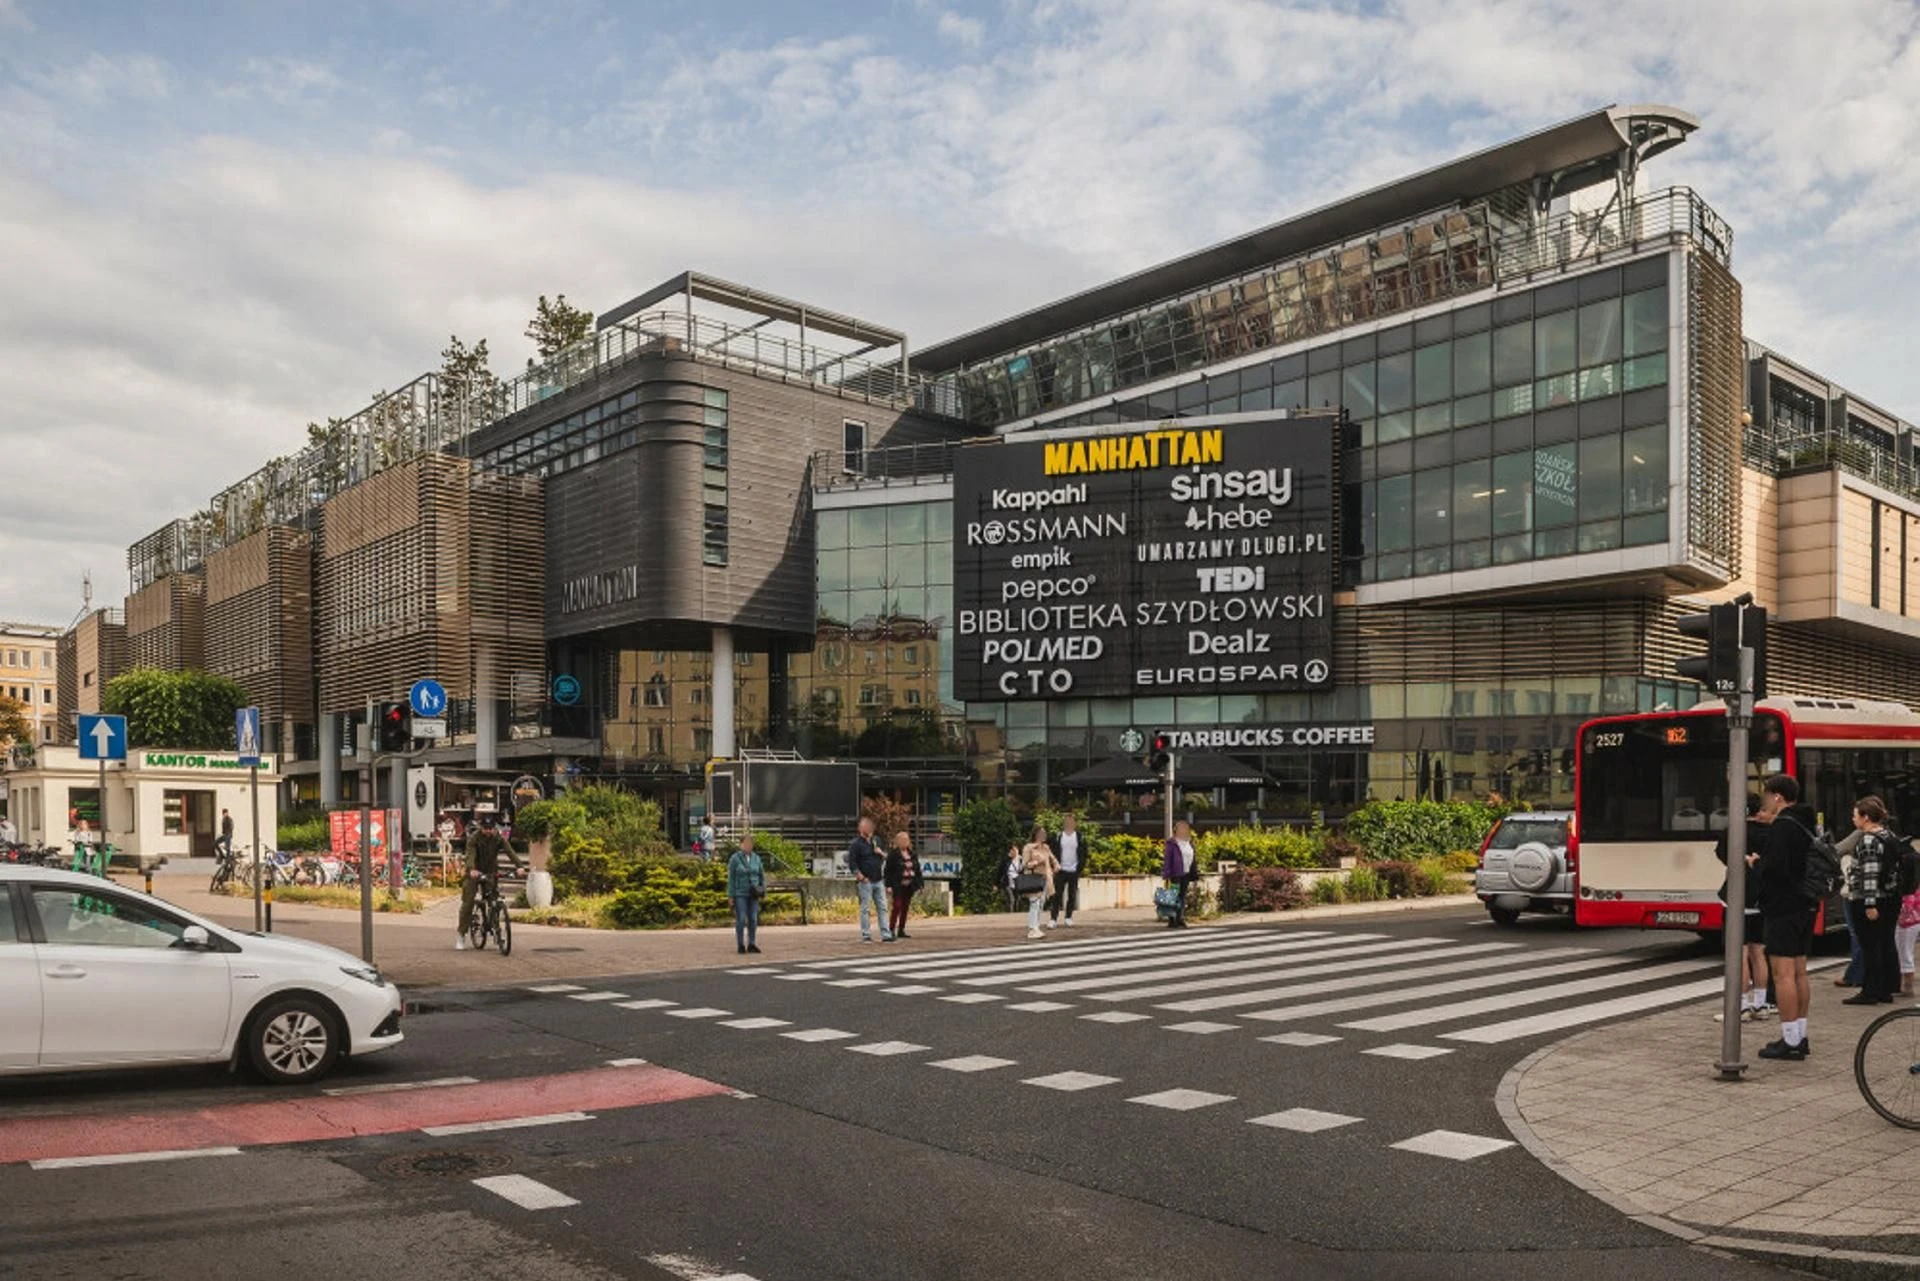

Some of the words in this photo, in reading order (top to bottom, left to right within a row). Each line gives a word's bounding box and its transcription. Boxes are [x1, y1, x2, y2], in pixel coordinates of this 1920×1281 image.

[1044, 429, 1223, 474] MANHATTAN
[992, 483, 1087, 511] Kappahl
[1170, 466, 1292, 506] sinsay
[967, 512, 1127, 546] ROSSMANN
[1206, 502, 1273, 531] hebe
[1011, 545, 1072, 570] empik
[1138, 538, 1235, 561] UMARZAMY
[1196, 566, 1265, 592] TEDi
[959, 603, 1128, 635] BIBLIOTEKA
[1136, 595, 1324, 626] SZYDŁOWSKI
[983, 635, 1104, 664] POLMED
[1188, 629, 1271, 655] Dealz
[1136, 664, 1299, 684] EUROSPAR
[1292, 725, 1375, 745] COFFEE
[1596, 732, 1625, 748] 2527
[145, 753, 207, 768] KANTOR
